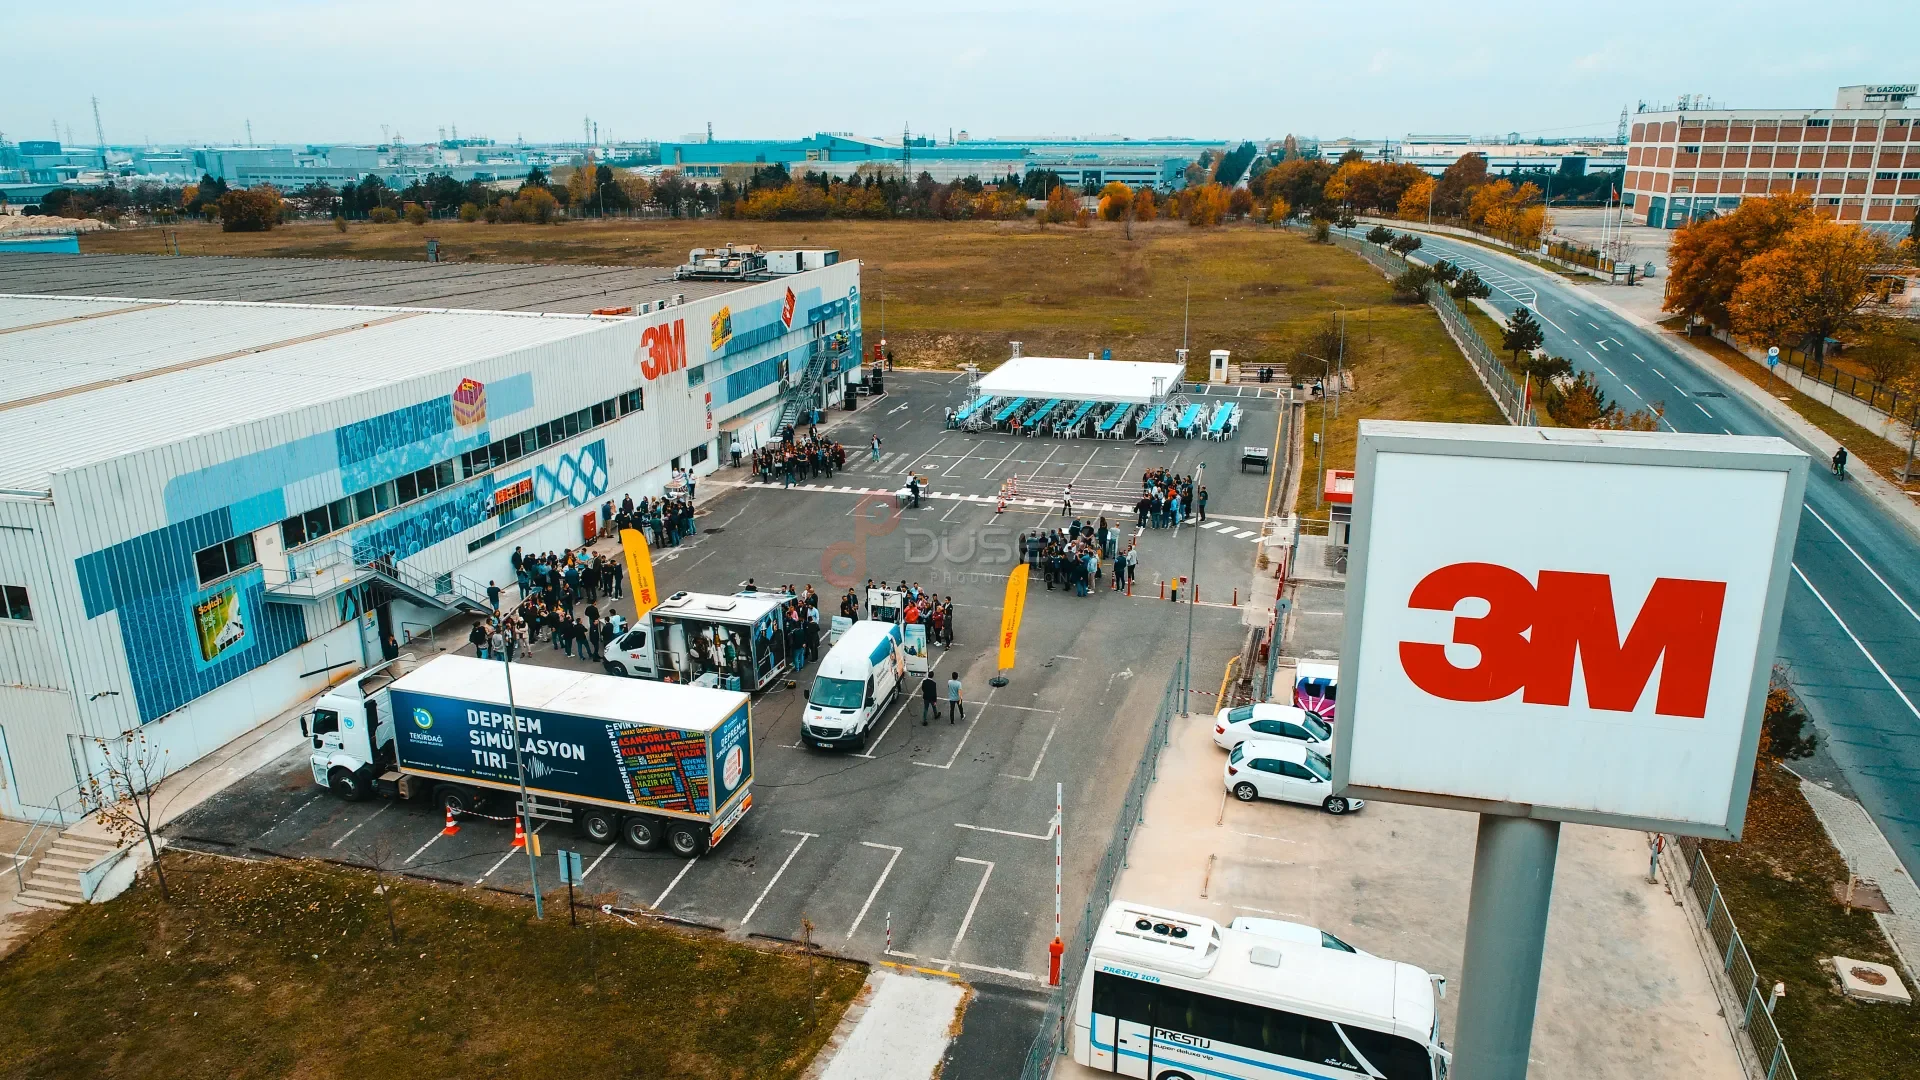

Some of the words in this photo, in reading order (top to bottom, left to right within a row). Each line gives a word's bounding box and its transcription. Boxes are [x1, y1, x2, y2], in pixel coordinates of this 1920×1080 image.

[640, 318, 687, 381] 3M
[198, 597, 222, 615] Scotch
[1003, 631, 1013, 648] 3M
[1398, 562, 1727, 719] 3M
[466, 709, 542, 735] DEPREM
[409, 731, 443, 743] TEKİRDAĞ
[619, 731, 680, 747] ASANSÖRLERİ
[720, 722, 741, 748] DEPREM
[471, 749, 507, 769] TIRI
[611, 740, 624, 765] HAZIR
[621, 743, 672, 757] KULLANMA
[619, 766, 637, 805] DEPREME
[637, 779, 660, 788] HAZIR
[1141, 974, 1161, 983] 2014
[1153, 1043, 1176, 1052] super
[1154, 1028, 1211, 1049] PRESTIJ
[1324, 1058, 1341, 1066] Royal
